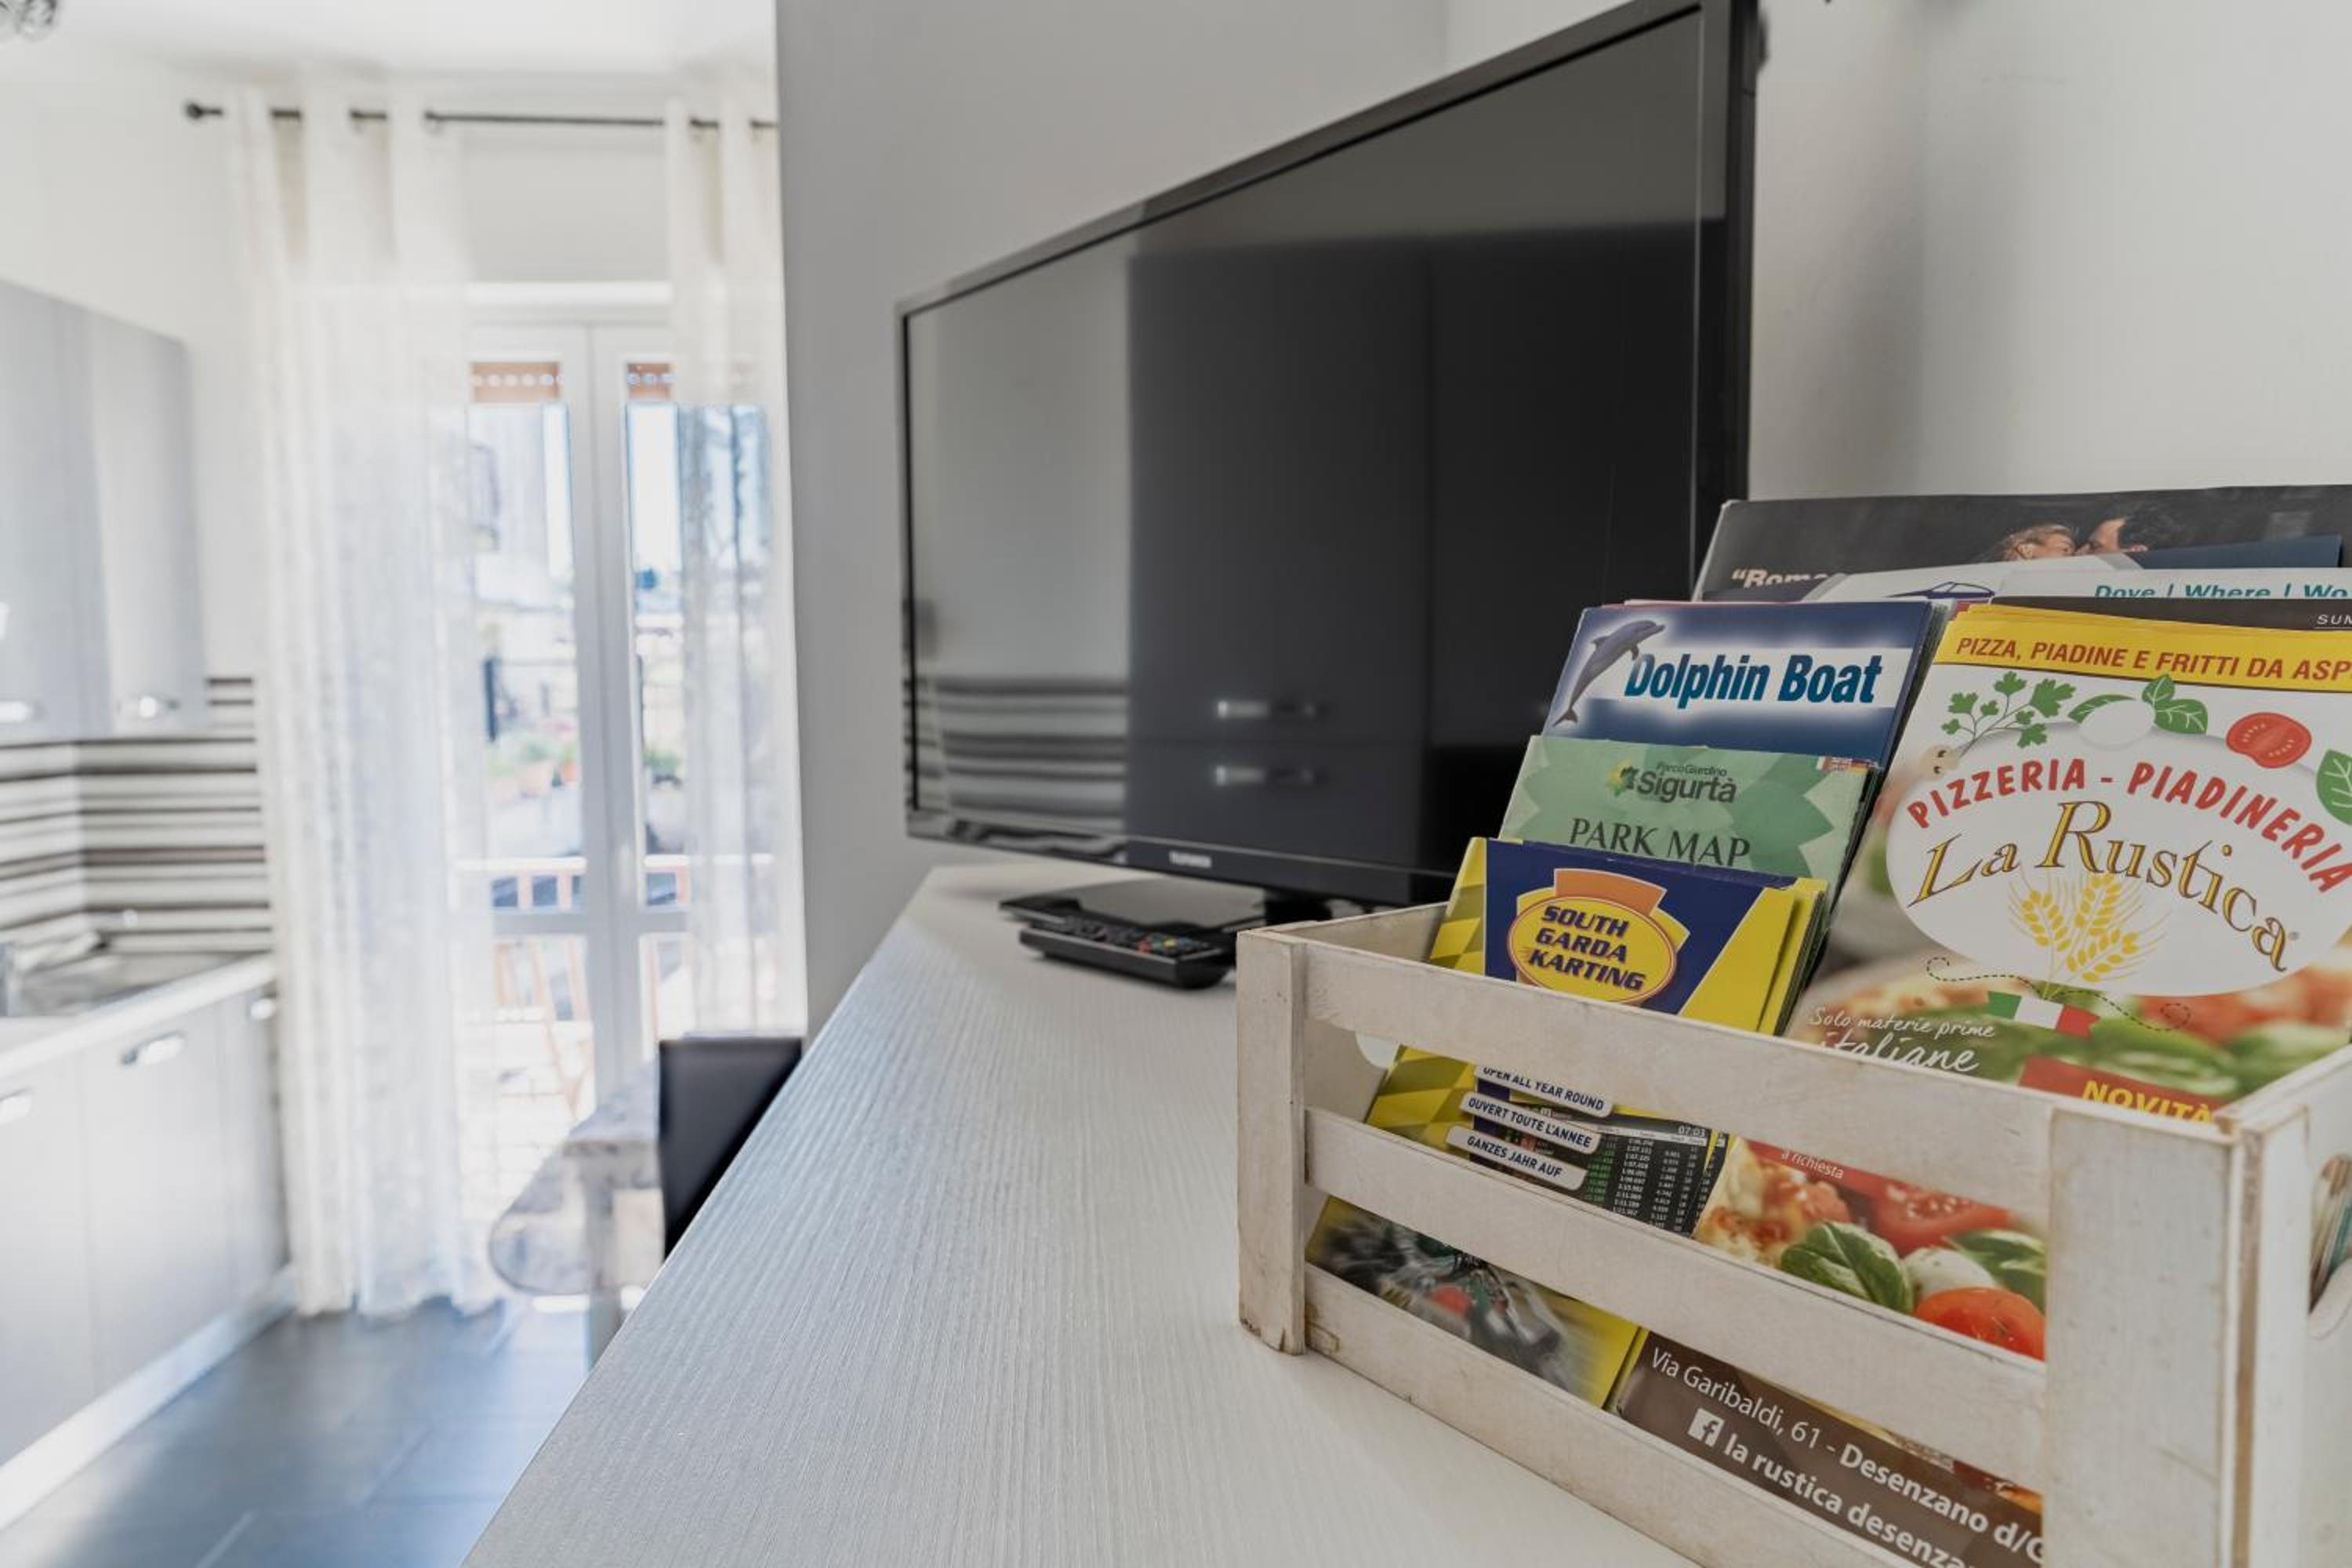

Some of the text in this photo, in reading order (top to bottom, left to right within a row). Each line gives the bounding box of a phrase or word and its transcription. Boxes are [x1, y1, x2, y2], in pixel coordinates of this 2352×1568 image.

[2095, 585, 2155, 597] Dove
[2185, 583, 2271, 597] Where
[1956, 637, 2021, 661] PIZZA,
[2031, 641, 2128, 667] PIADINE
[2132, 650, 2150, 669] E
[2156, 652, 2240, 676] FRITTI
[2246, 658, 2283, 677] DA
[1624, 654, 1883, 709] Dolphin Boat
[1637, 772, 1737, 804] Sigurtà
[1570, 817, 1750, 866] PARK MAP
[1907, 758, 2085, 829] PIZZERIA
[2126, 761, 2352, 894] PIADINERIA
[1906, 800, 2288, 972] La Rustica
[1541, 905, 1629, 938] SOUTH
[1535, 927, 1628, 964] GARDA
[1528, 949, 1646, 992] KARTING
[1807, 1007, 1996, 1040] Solo materie prime
[1512, 1073, 1531, 1088] ALL
[1534, 1079, 1563, 1098] YEAR
[1564, 1090, 1606, 1111] ROUND
[2082, 1080, 2213, 1123] NOVITÀ
[1468, 1098, 1511, 1120] OUVERT
[1511, 1112, 1544, 1132] TOUTE
[1545, 1122, 1593, 1149] L'ANNEE
[1467, 1135, 1563, 1178] GANZES JAHR AUF
[1791, 1153, 1845, 1180] richiesta
[1652, 1347, 1680, 1377] Via
[1683, 1366, 1786, 1436] Garibaldi,
[1791, 1421, 1821, 1449] 61
[1839, 1443, 1989, 1533] Desenzano
[1725, 1433, 1750, 1465] la
[1752, 1454, 1843, 1515] rustica
[1846, 1502, 1976, 1568] desenza
